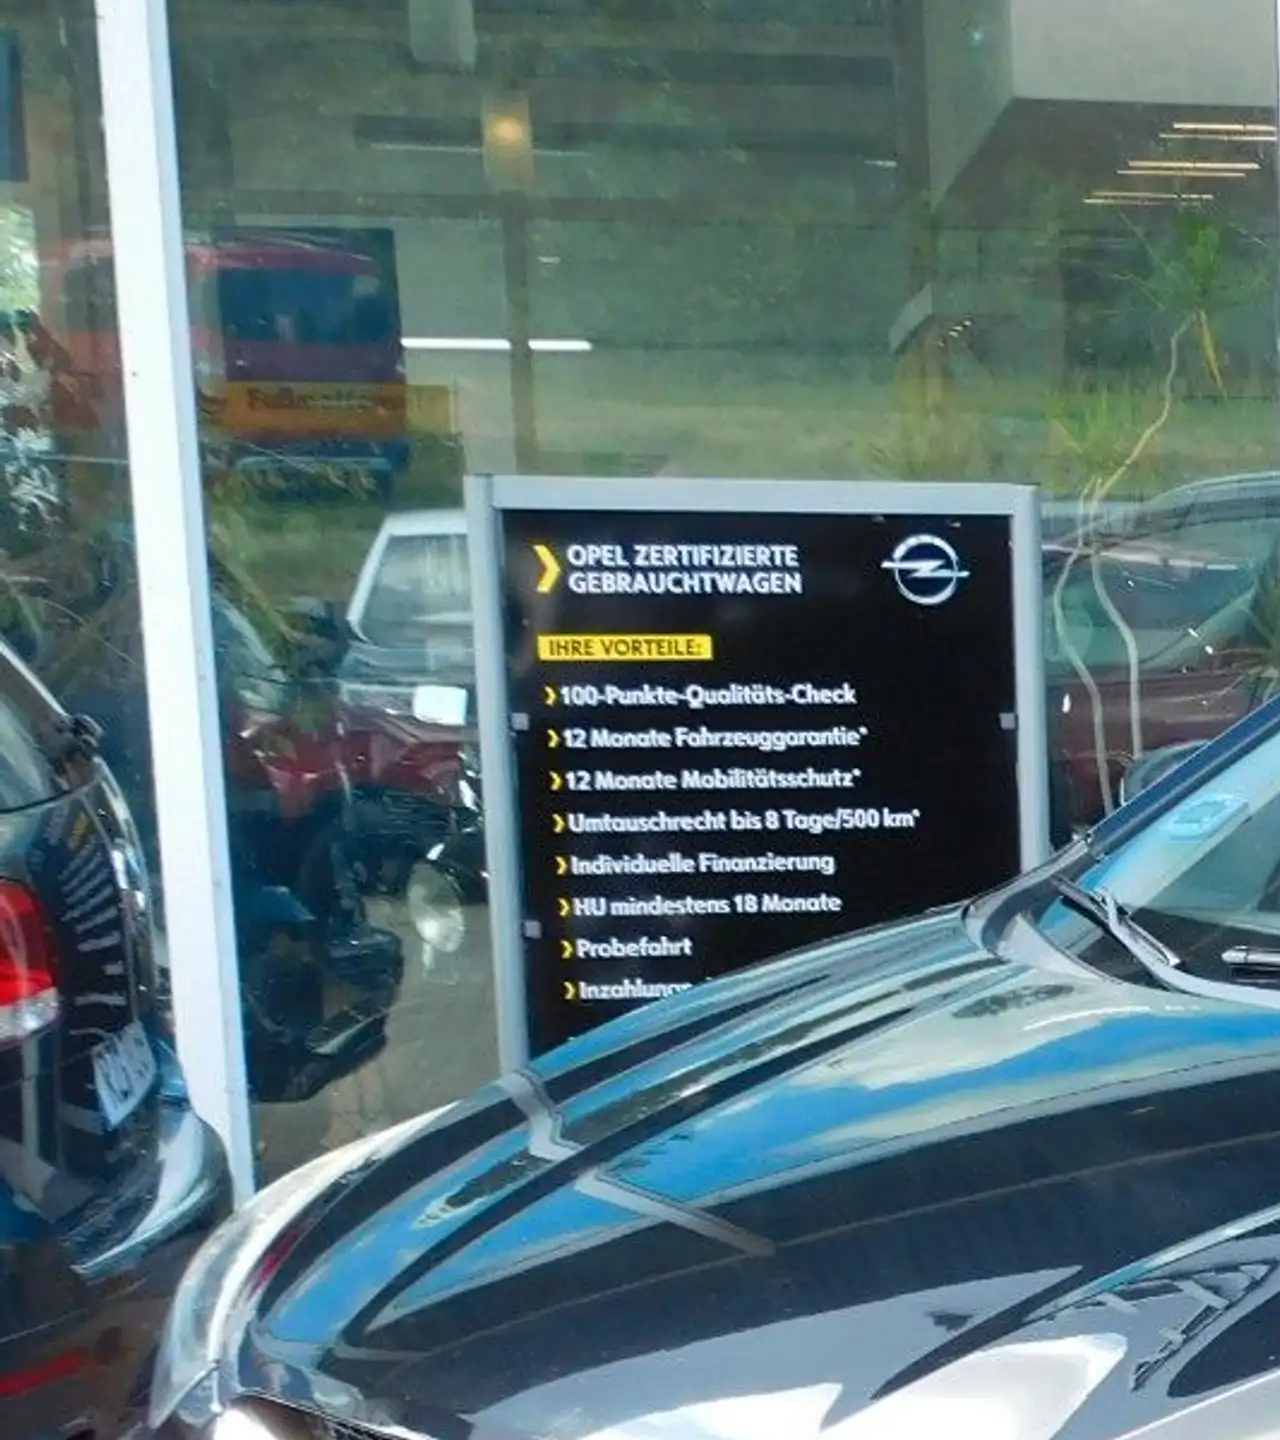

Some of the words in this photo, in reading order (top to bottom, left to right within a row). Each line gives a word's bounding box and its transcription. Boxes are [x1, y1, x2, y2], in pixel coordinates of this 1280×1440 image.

[567, 544, 630, 567] OPEL
[633, 544, 800, 568] ZERTIFIZIERTE
[568, 571, 803, 594] GEBRAUCHTWAGEN
[549, 638, 599, 656] IHRE
[600, 638, 703, 656] VORTEILE:
[559, 682, 858, 709] 100-Punkte-Qualitäts-Check
[562, 729, 588, 749] 12
[590, 728, 672, 748] Monate
[565, 771, 592, 791] 12
[594, 769, 678, 790] Monate
[567, 810, 728, 834] Umtauschrecht
[731, 810, 764, 830] bis
[765, 809, 782, 830] 8
[783, 808, 881, 834] Tage/500
[571, 853, 697, 876] Individuelle
[699, 851, 837, 876] Finanzierung
[573, 896, 608, 917] HU
[610, 894, 733, 915] mindestens
[733, 893, 760, 913] 18
[761, 892, 844, 912] Monate
[576, 936, 694, 958] Probefahrt
